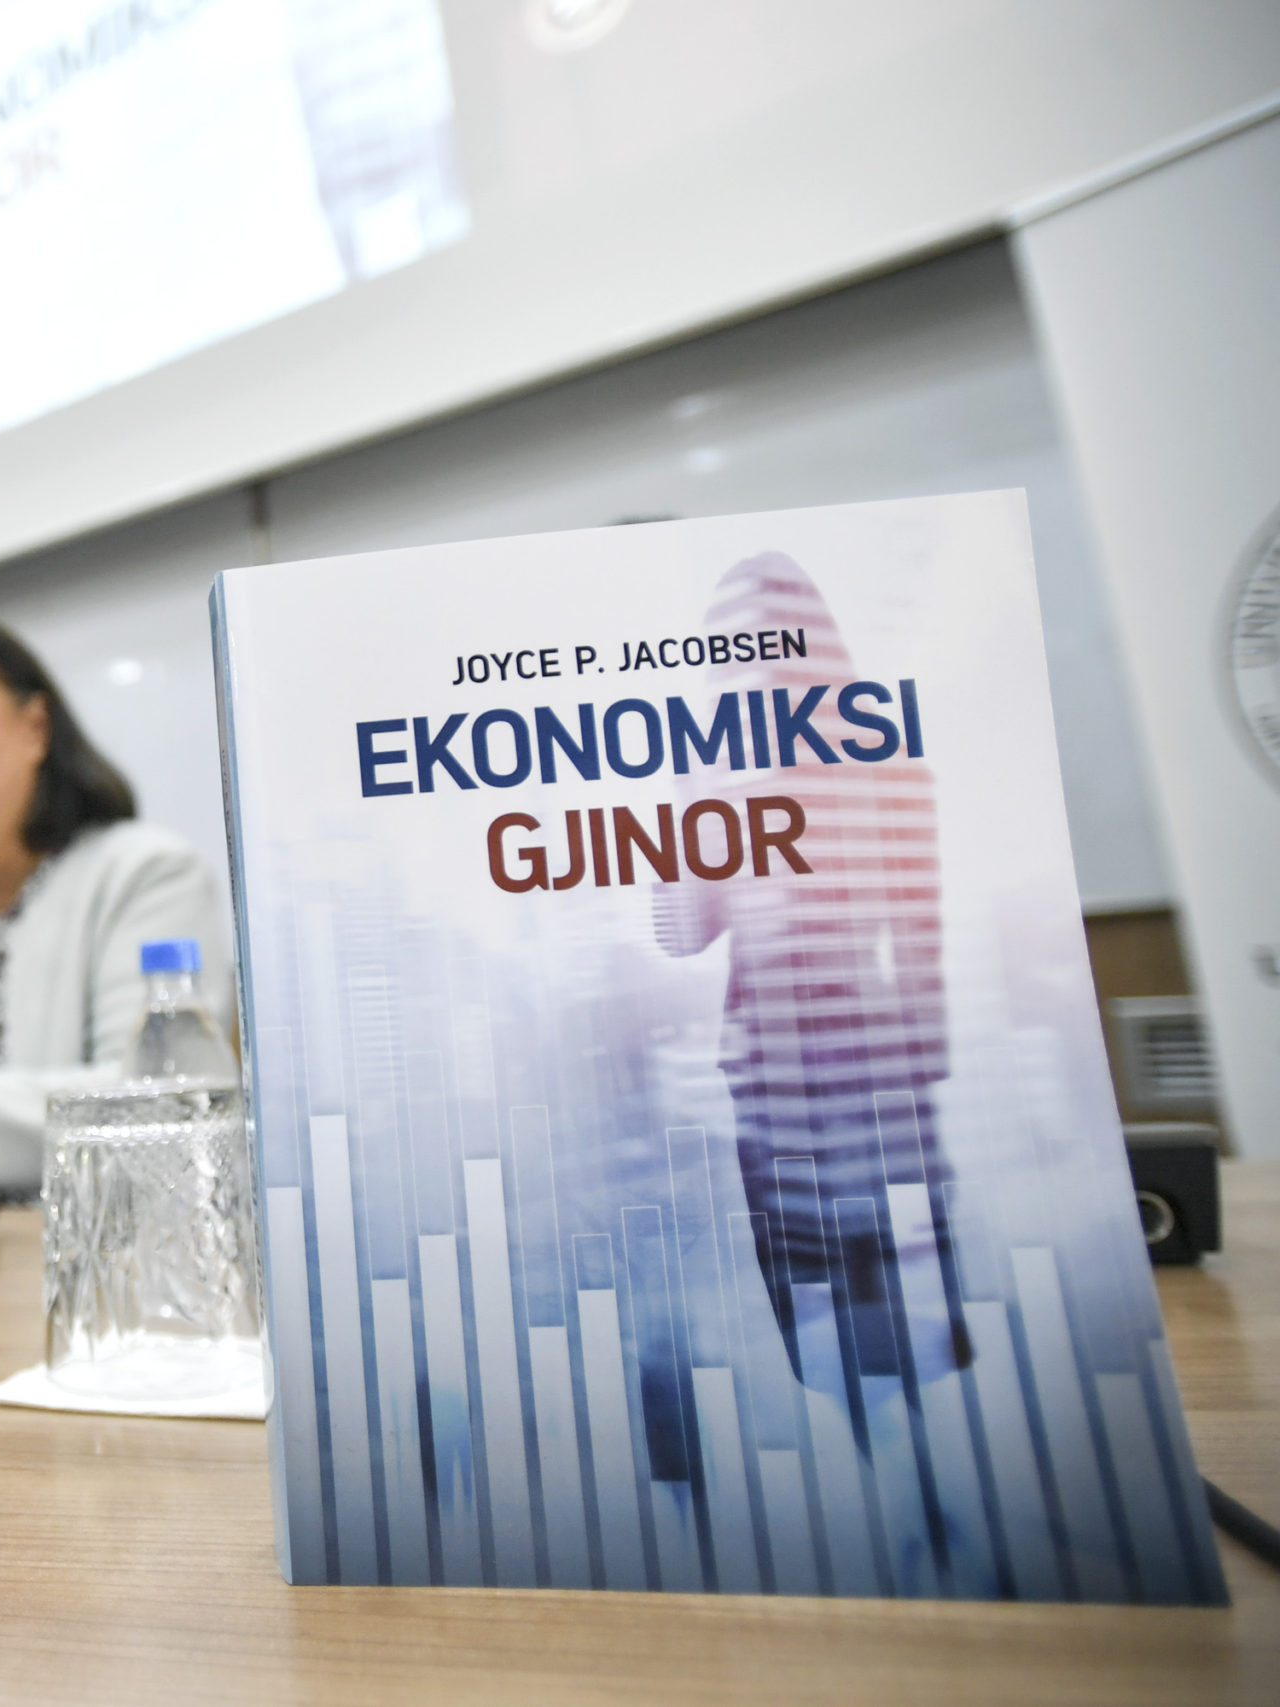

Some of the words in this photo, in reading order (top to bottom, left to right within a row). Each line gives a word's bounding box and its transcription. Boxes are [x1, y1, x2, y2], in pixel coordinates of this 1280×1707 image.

[452, 648, 562, 686] JOYCE
[575, 645, 605, 675] P.
[619, 628, 808, 672] JACOBSEN
[355, 678, 925, 798] EKONOMIKSI
[486, 795, 815, 894] GJINOR
